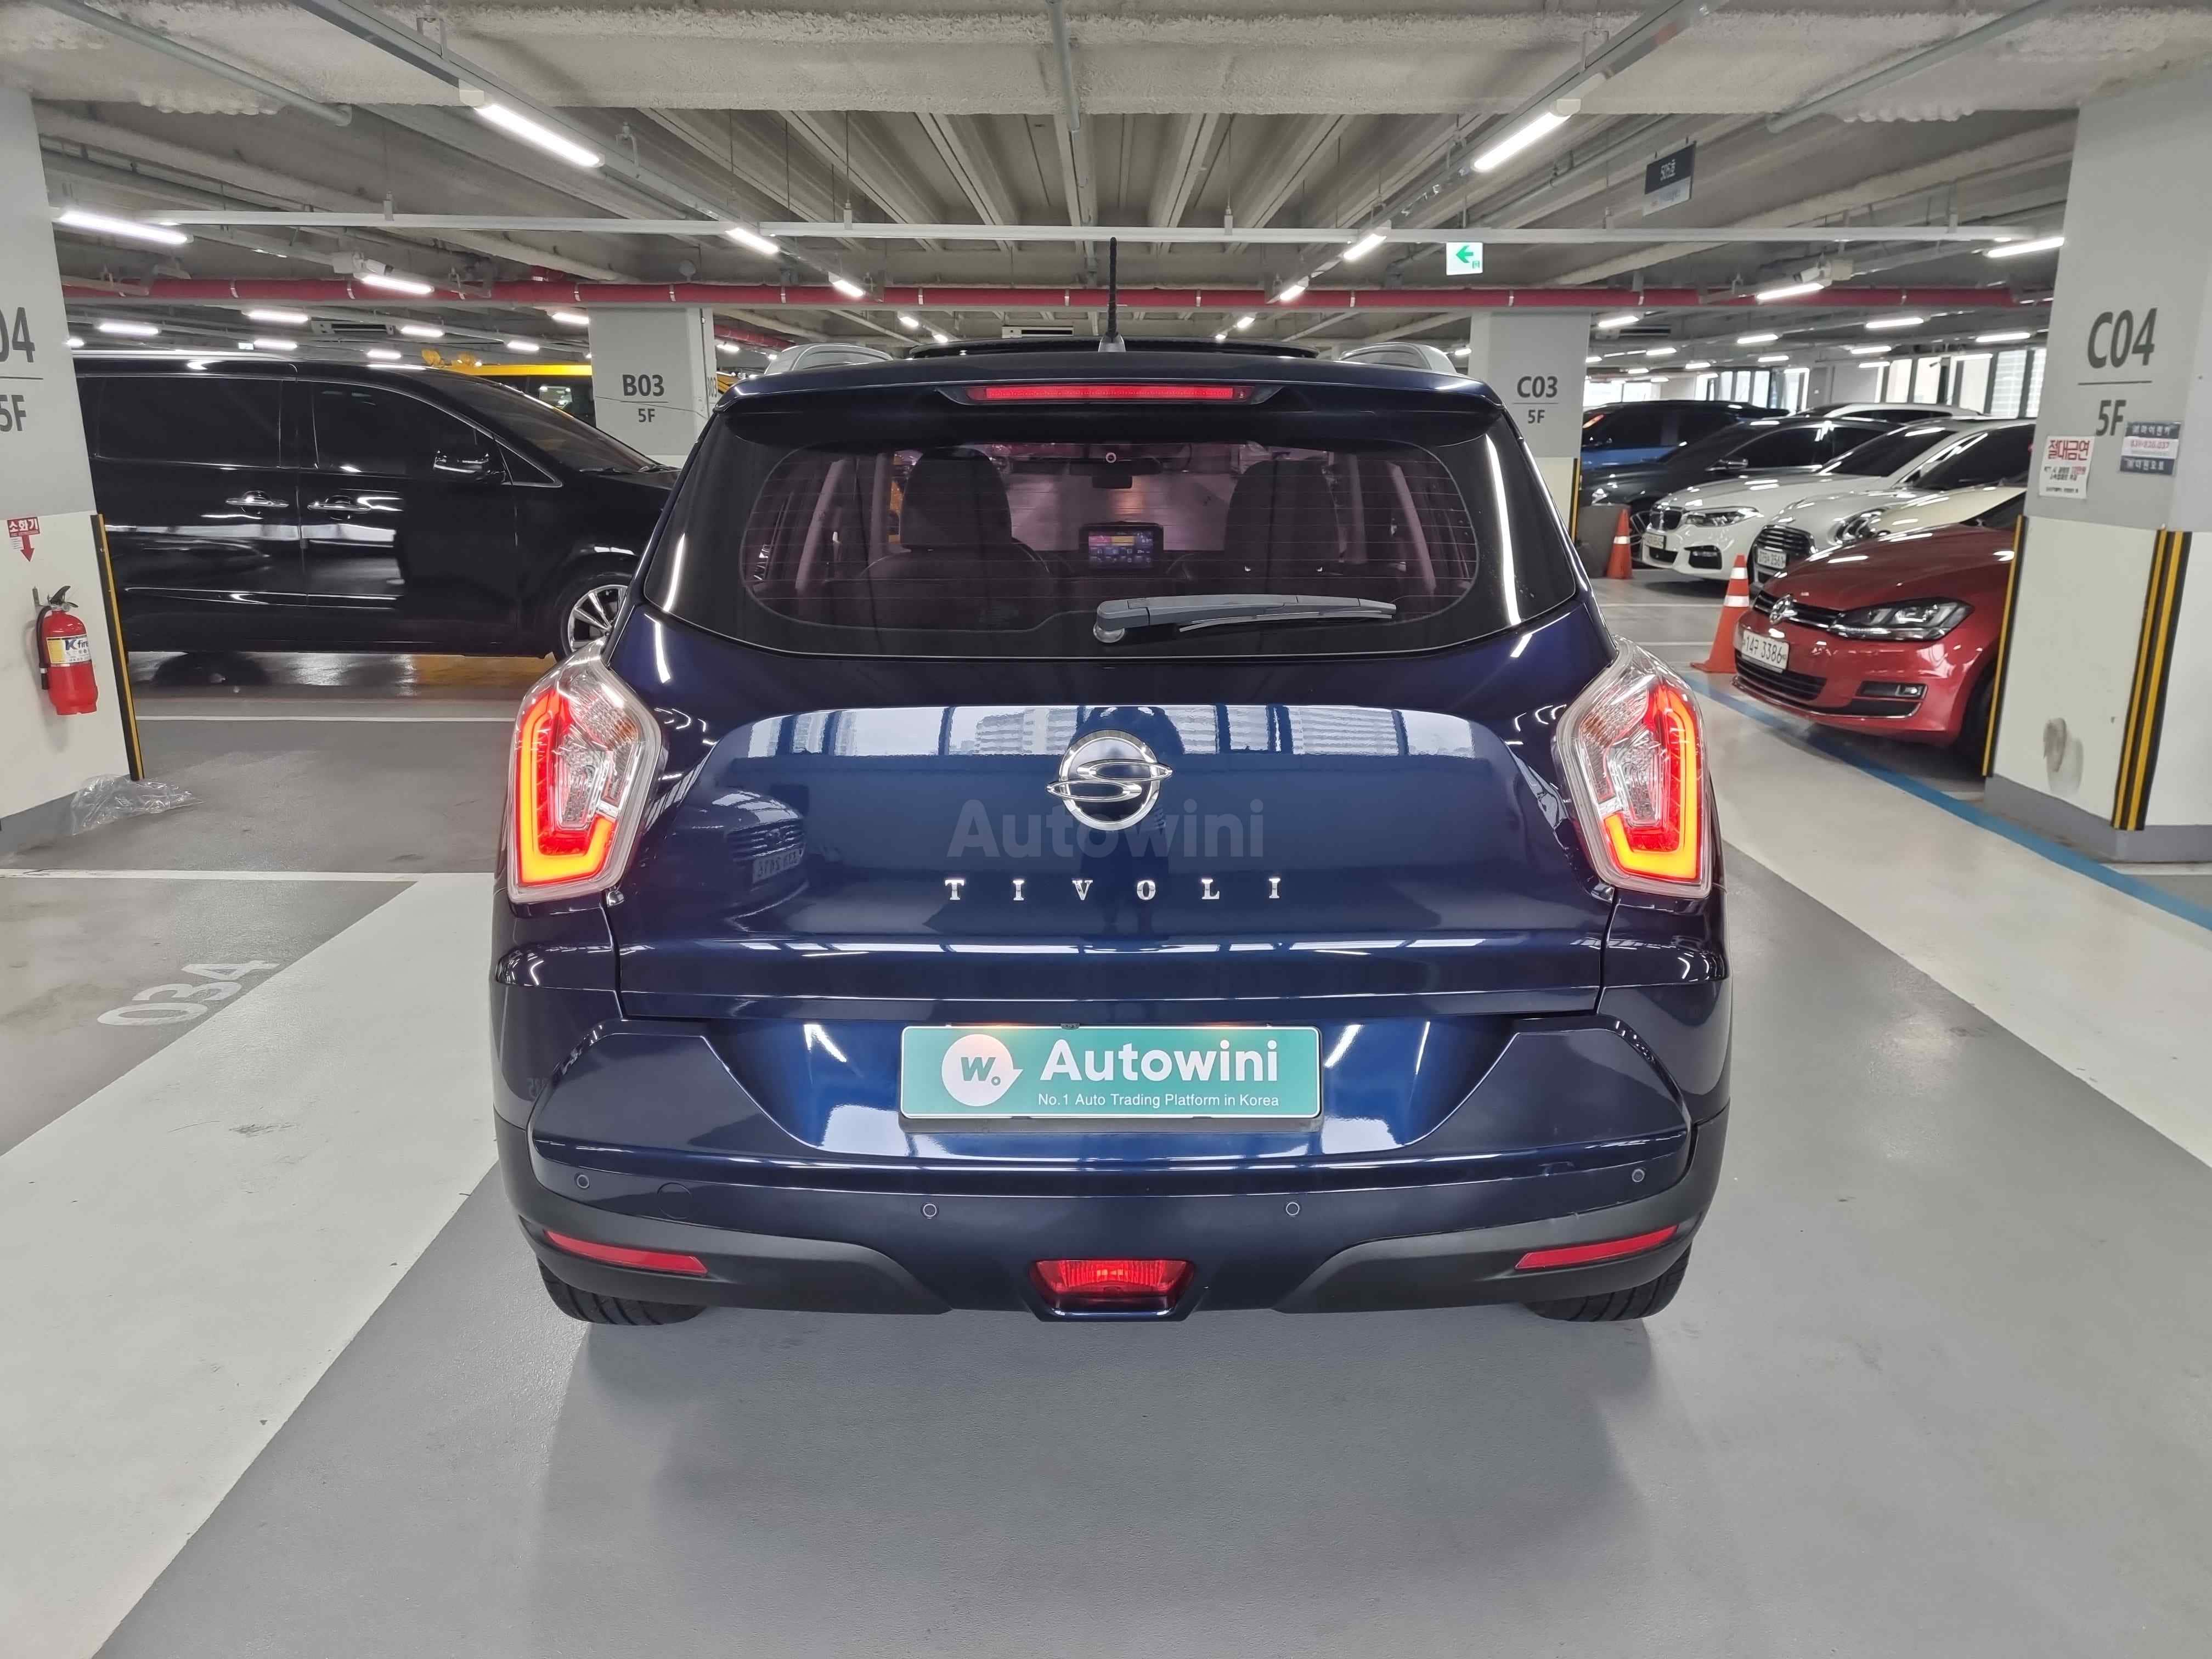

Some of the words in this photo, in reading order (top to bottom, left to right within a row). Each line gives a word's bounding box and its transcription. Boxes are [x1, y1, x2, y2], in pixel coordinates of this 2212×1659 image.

[2087, 307, 2158, 369] C04
[622, 374, 664, 396] B03
[1517, 376, 1558, 398] C03
[638, 408, 655, 422] 5F
[1528, 409, 1545, 424] 5F
[2096, 399, 2126, 436] 5F
[2048, 440, 2090, 460] 절대금연
[9, 518, 39, 532] 소화기
[1761, 641, 1782, 663] 3386
[97, 960, 281, 1026] 034
[1040, 1039, 1278, 1081] Autowini
[1075, 1093, 1105, 1105] Auto
[1110, 1094, 1160, 1108] Trading
[1165, 1093, 1220, 1106] Platform
[1224, 1094, 1235, 1105] in
[1240, 1094, 1279, 1106] Korea
